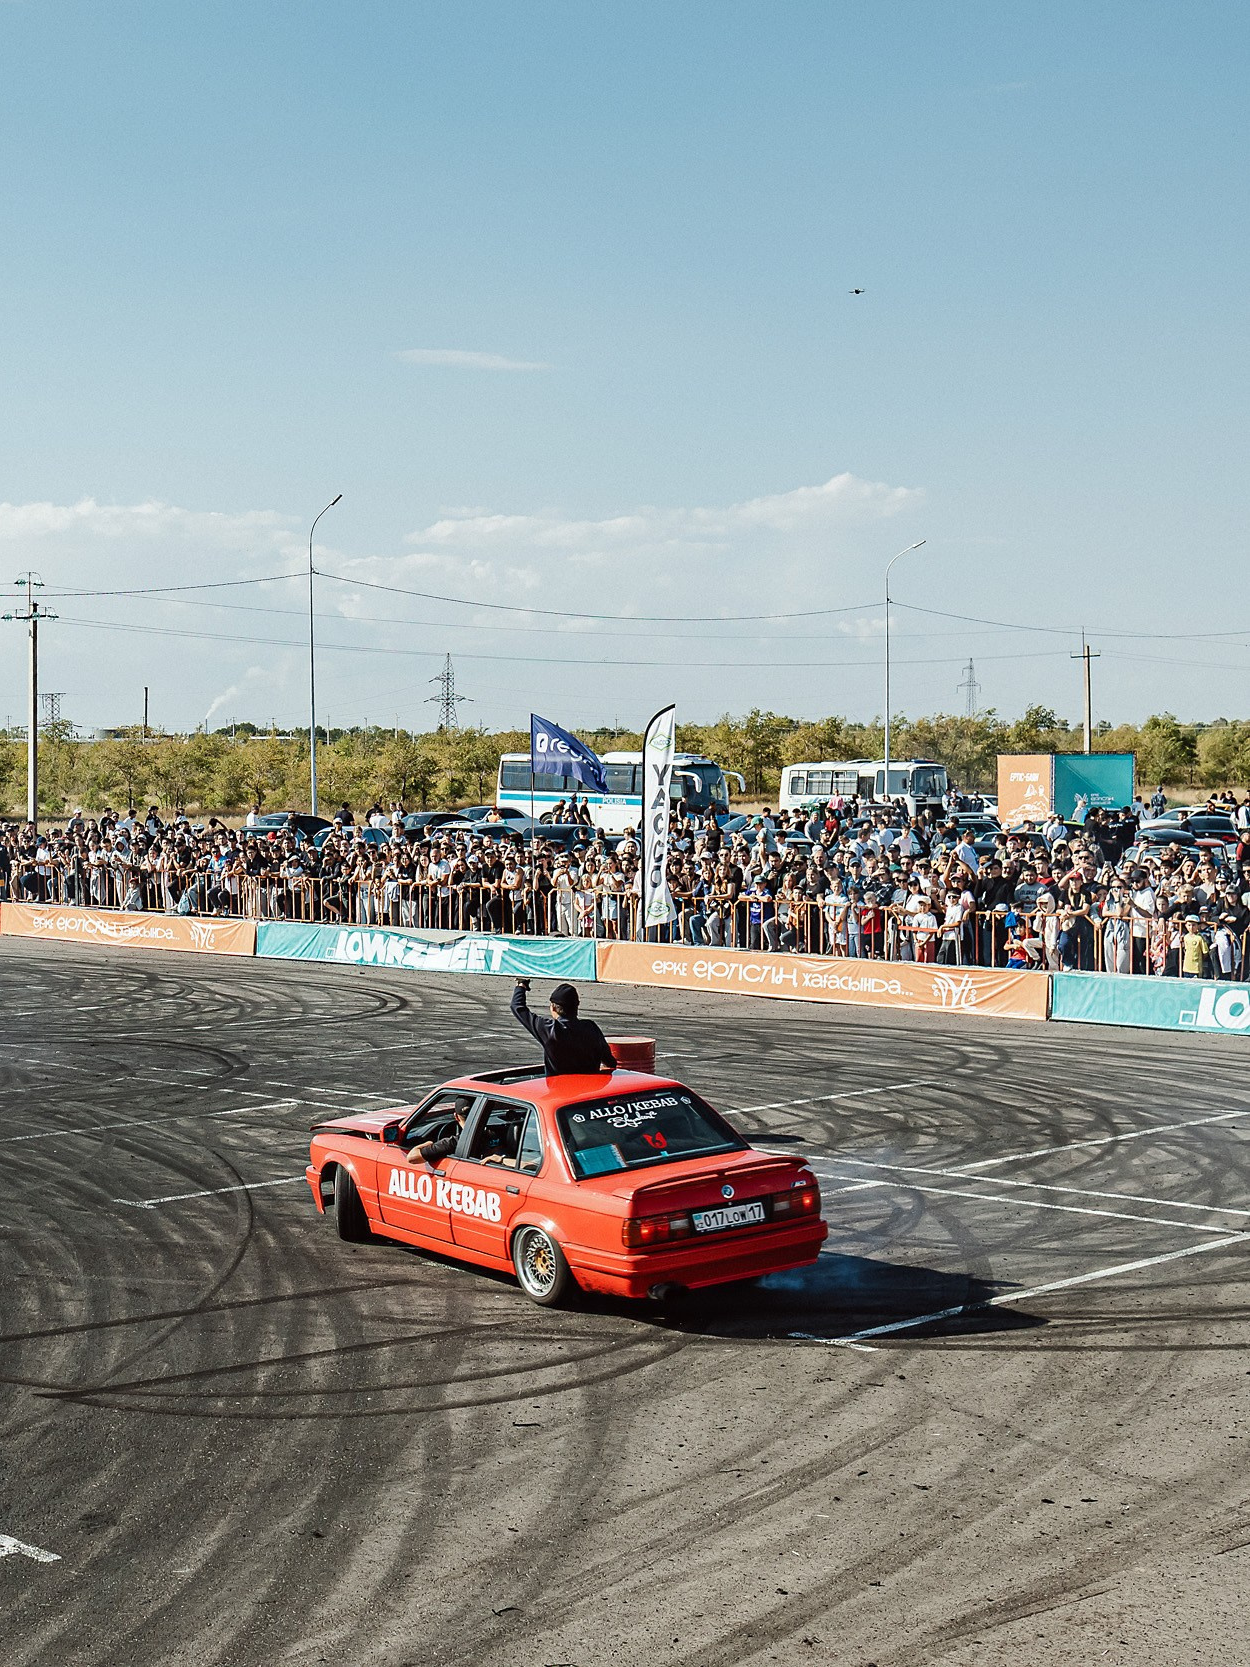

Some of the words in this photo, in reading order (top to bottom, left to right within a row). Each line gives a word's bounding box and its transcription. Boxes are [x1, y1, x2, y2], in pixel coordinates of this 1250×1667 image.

[650, 764, 670, 888] YACCO
[388, 1168, 433, 1203] ALLO
[436, 1179, 502, 1223] KEBAB
